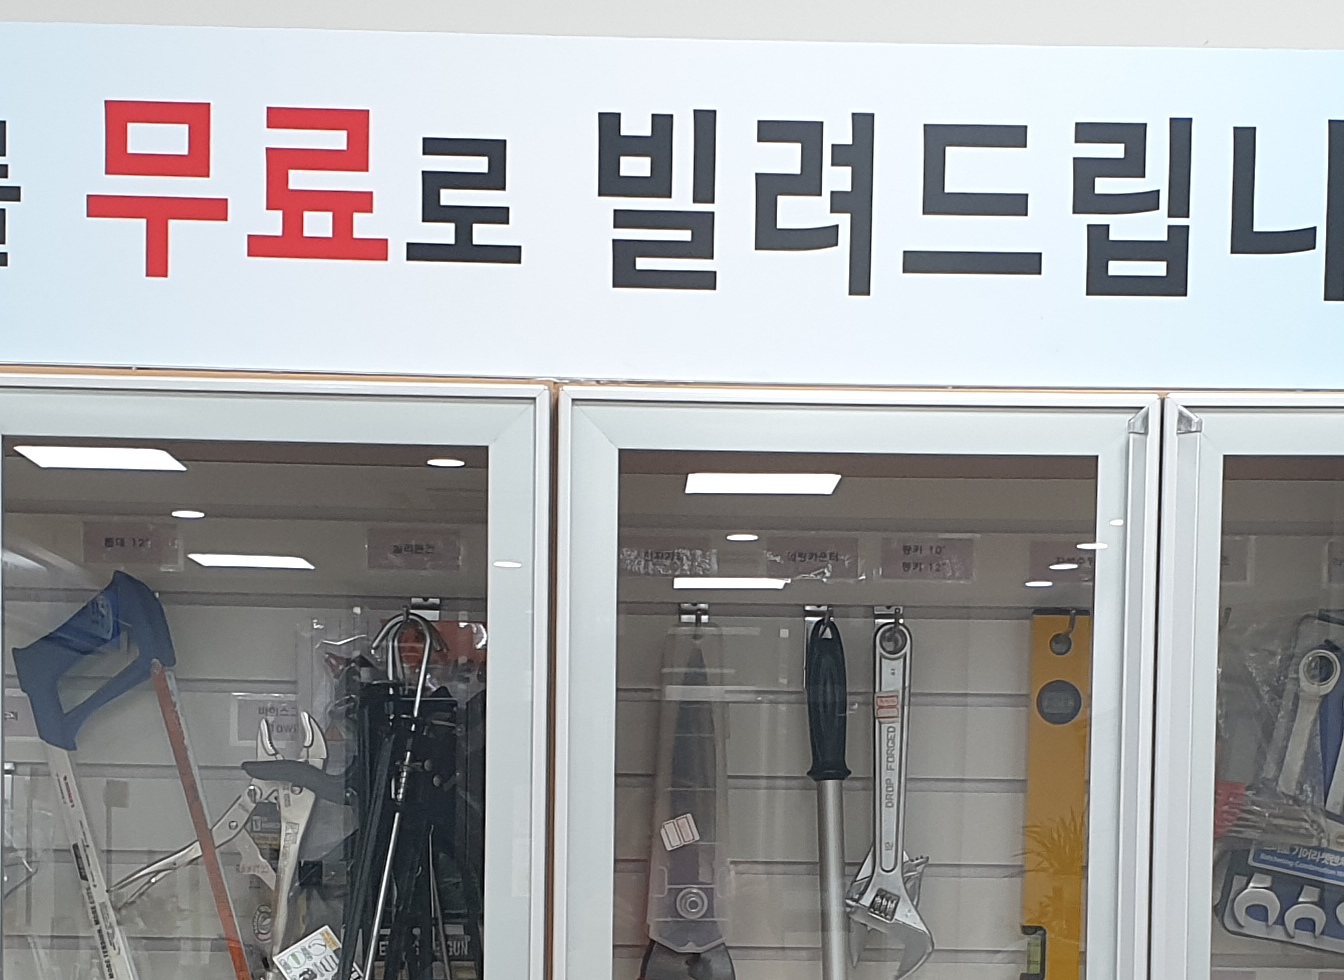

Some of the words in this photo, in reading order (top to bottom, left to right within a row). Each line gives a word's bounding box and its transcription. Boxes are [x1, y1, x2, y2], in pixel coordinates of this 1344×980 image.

[87, 101, 521, 277] 무료로
[885, 725, 897, 772] FORGED
[884, 778, 895, 809] DROP
